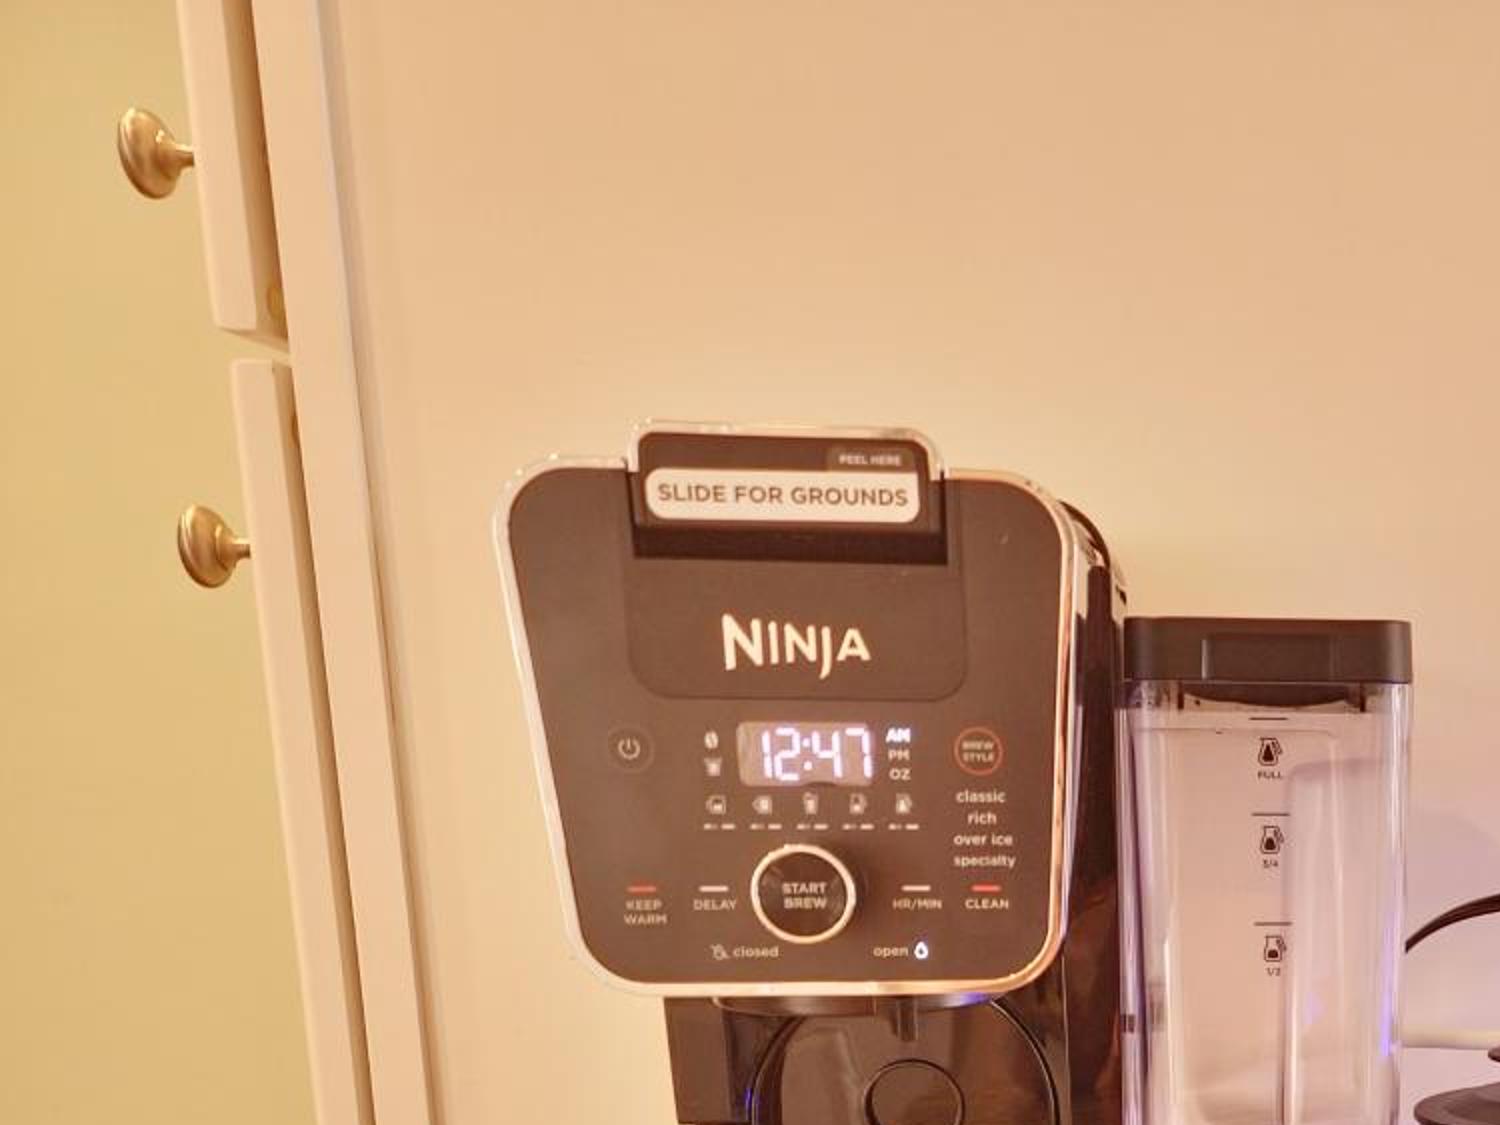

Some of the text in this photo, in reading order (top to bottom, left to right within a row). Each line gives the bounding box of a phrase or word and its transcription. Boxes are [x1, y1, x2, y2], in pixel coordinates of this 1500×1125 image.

[839, 454, 901, 466] PEEL HERE
[657, 481, 909, 507] SLIDE FOR GROUNDS
[720, 613, 871, 680] NINJA
[886, 727, 912, 744] AM
[962, 741, 995, 752] BREW
[760, 727, 875, 782] 12:47
[888, 750, 911, 762] PM
[962, 752, 996, 763] STYLE
[889, 768, 911, 780] OZ
[1257, 770, 1283, 780] FULL
[955, 789, 1006, 804] classic
[967, 811, 997, 825] rich
[953, 832, 1013, 846] over ice
[953, 853, 1017, 870] specialty
[782, 882, 827, 895] START
[625, 899, 663, 911] KEEP
[693, 899, 738, 911] DELAY
[783, 897, 829, 910] BREW
[892, 898, 942, 911] HR/MIN
[965, 898, 1009, 910] CLEAN
[623, 912, 668, 925] WARM
[732, 944, 779, 958] closed
[873, 945, 909, 959] open
[1266, 967, 1282, 977] 1/2
